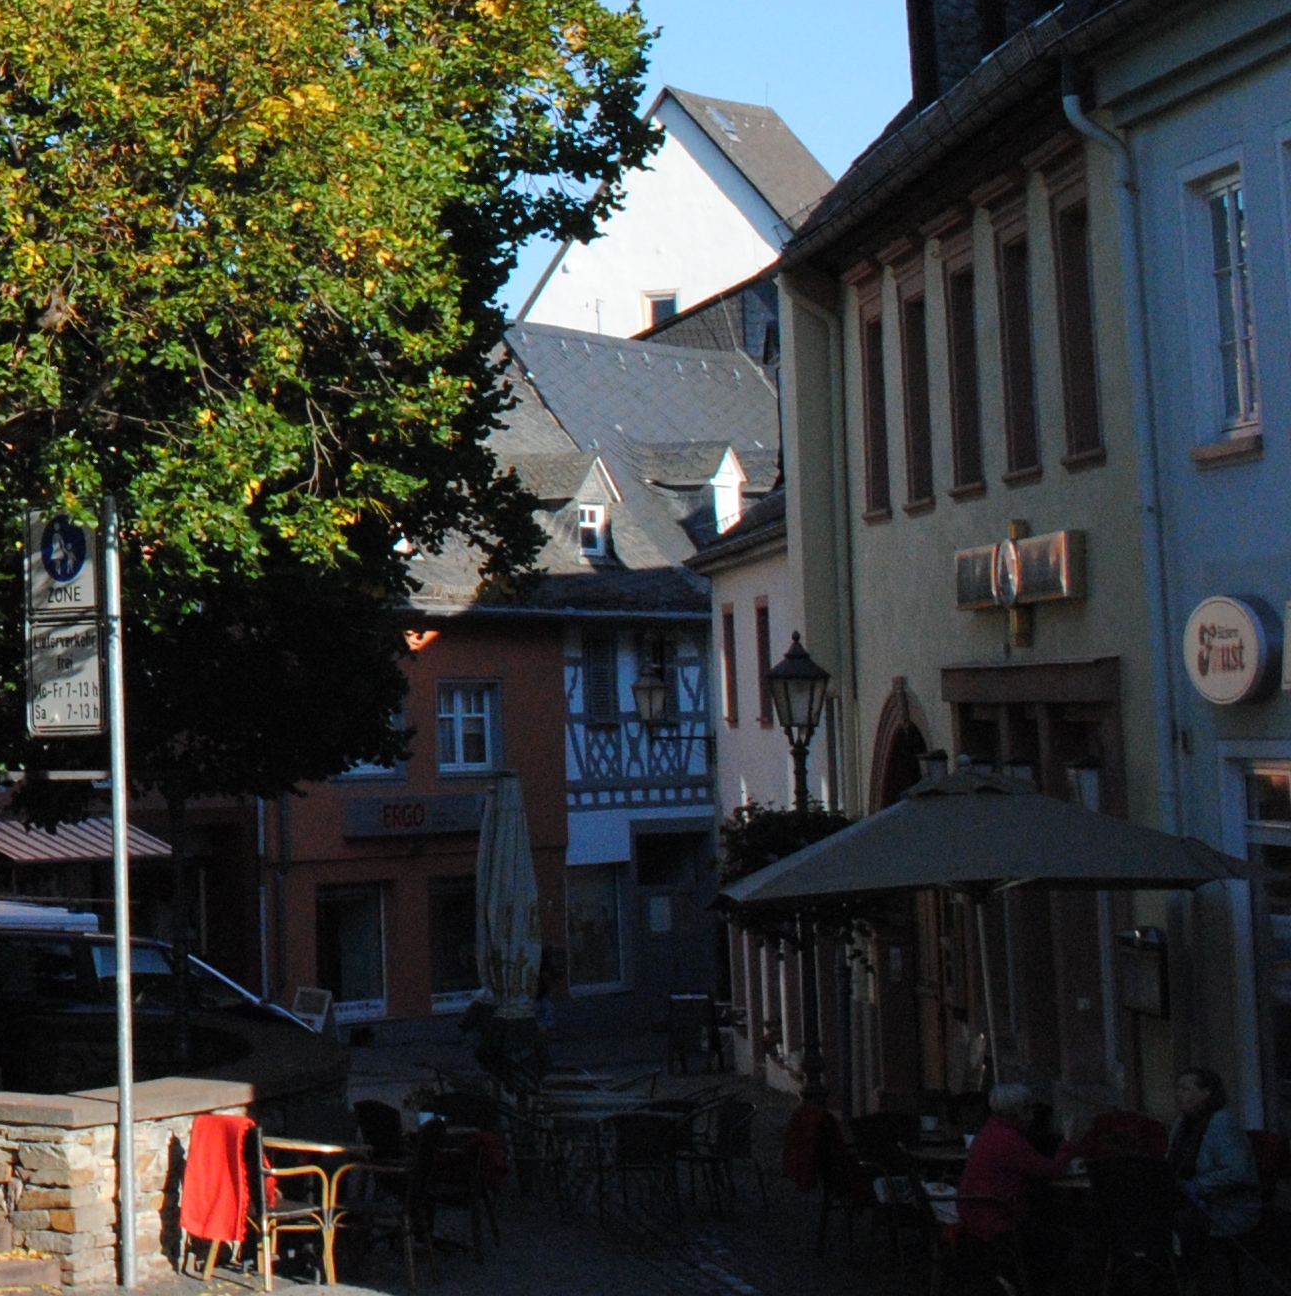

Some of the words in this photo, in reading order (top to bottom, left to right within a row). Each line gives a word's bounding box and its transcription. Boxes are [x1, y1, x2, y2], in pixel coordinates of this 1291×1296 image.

[47, 586, 82, 604] ZONE
[33, 631, 97, 650] Lieferverkehr
[56, 654, 74, 670] frei
[33, 682, 63, 699] Mo-Fr
[65, 681, 90, 698] 7-13
[92, 680, 99, 697] h
[34, 704, 47, 720] Sa
[66, 703, 90, 720] 7-13
[93, 703, 100, 719] h
[382, 802, 426, 829] ERGO
